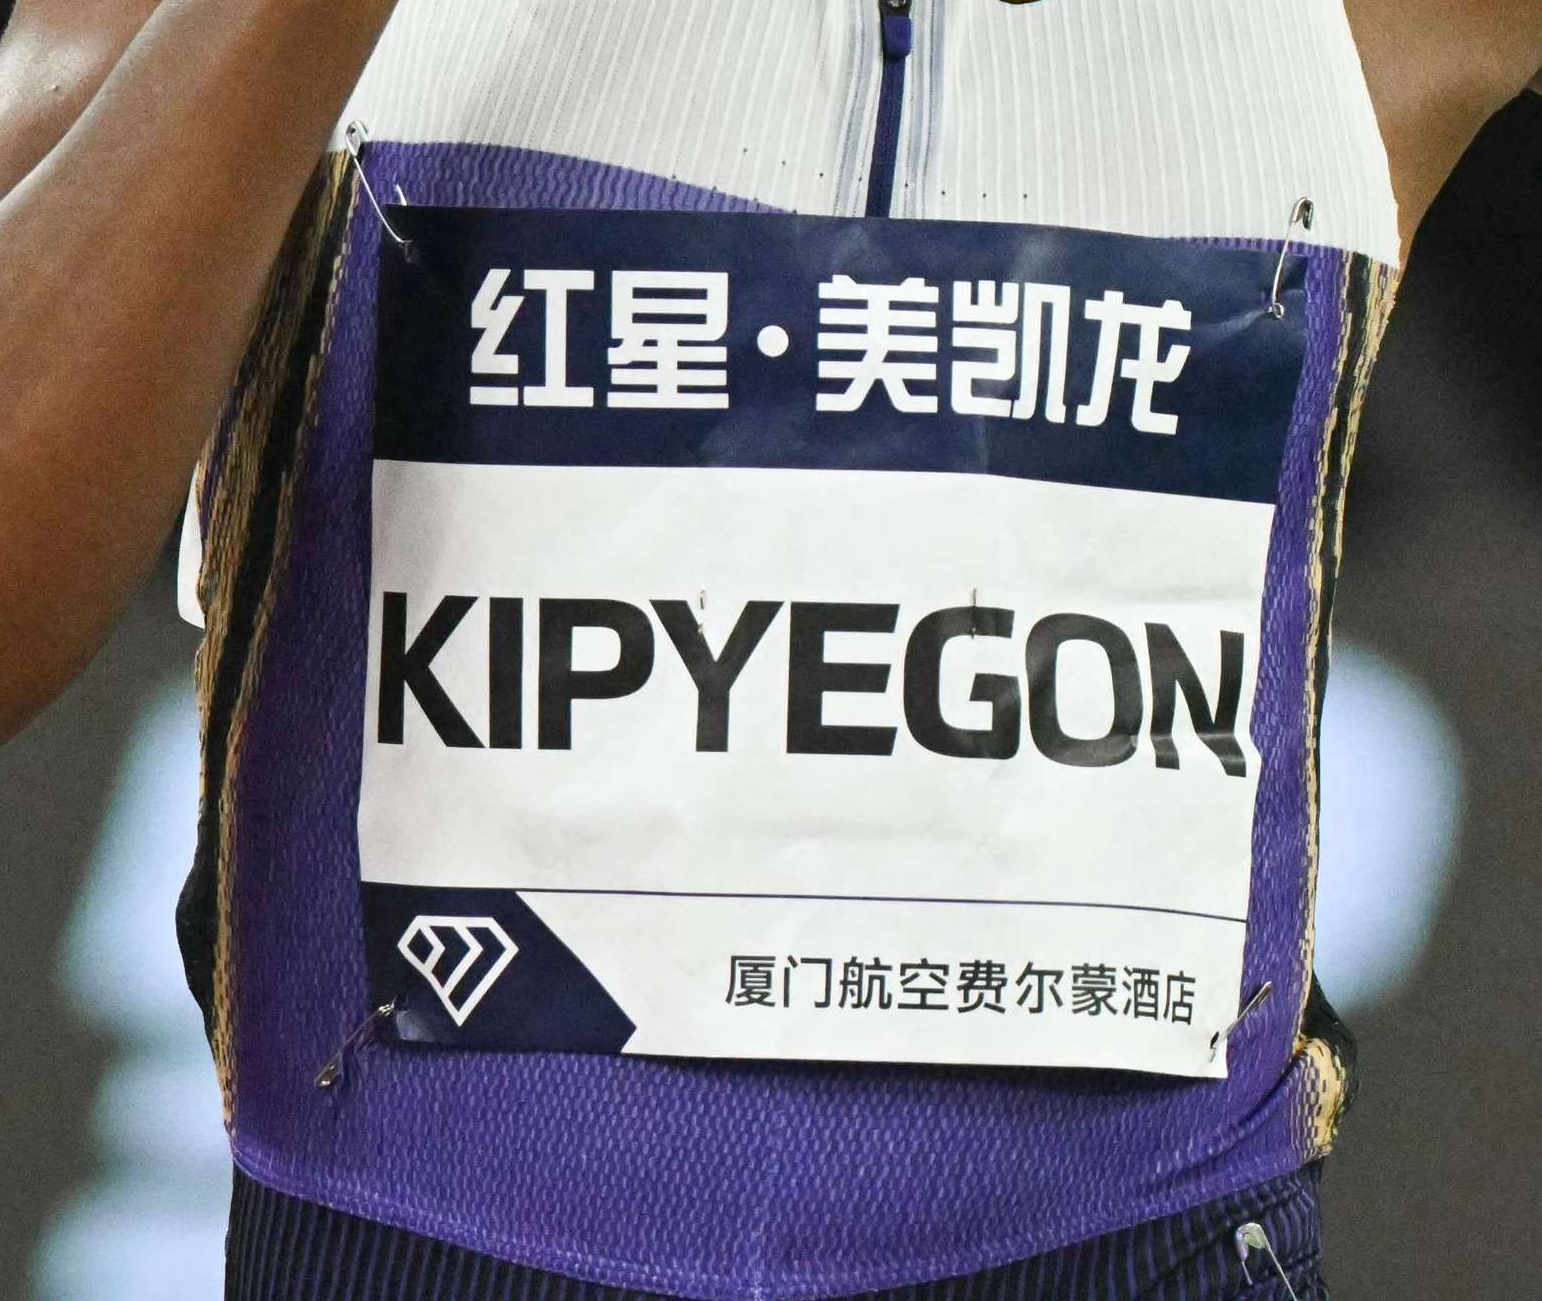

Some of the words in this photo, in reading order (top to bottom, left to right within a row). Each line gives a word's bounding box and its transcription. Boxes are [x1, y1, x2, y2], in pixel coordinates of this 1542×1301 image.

[469, 268, 1192, 435] 红星·美凯龙
[377, 590, 1247, 778] KIPYEGON
[724, 955, 1196, 1026] 厦门航空费尔蒙酒店
